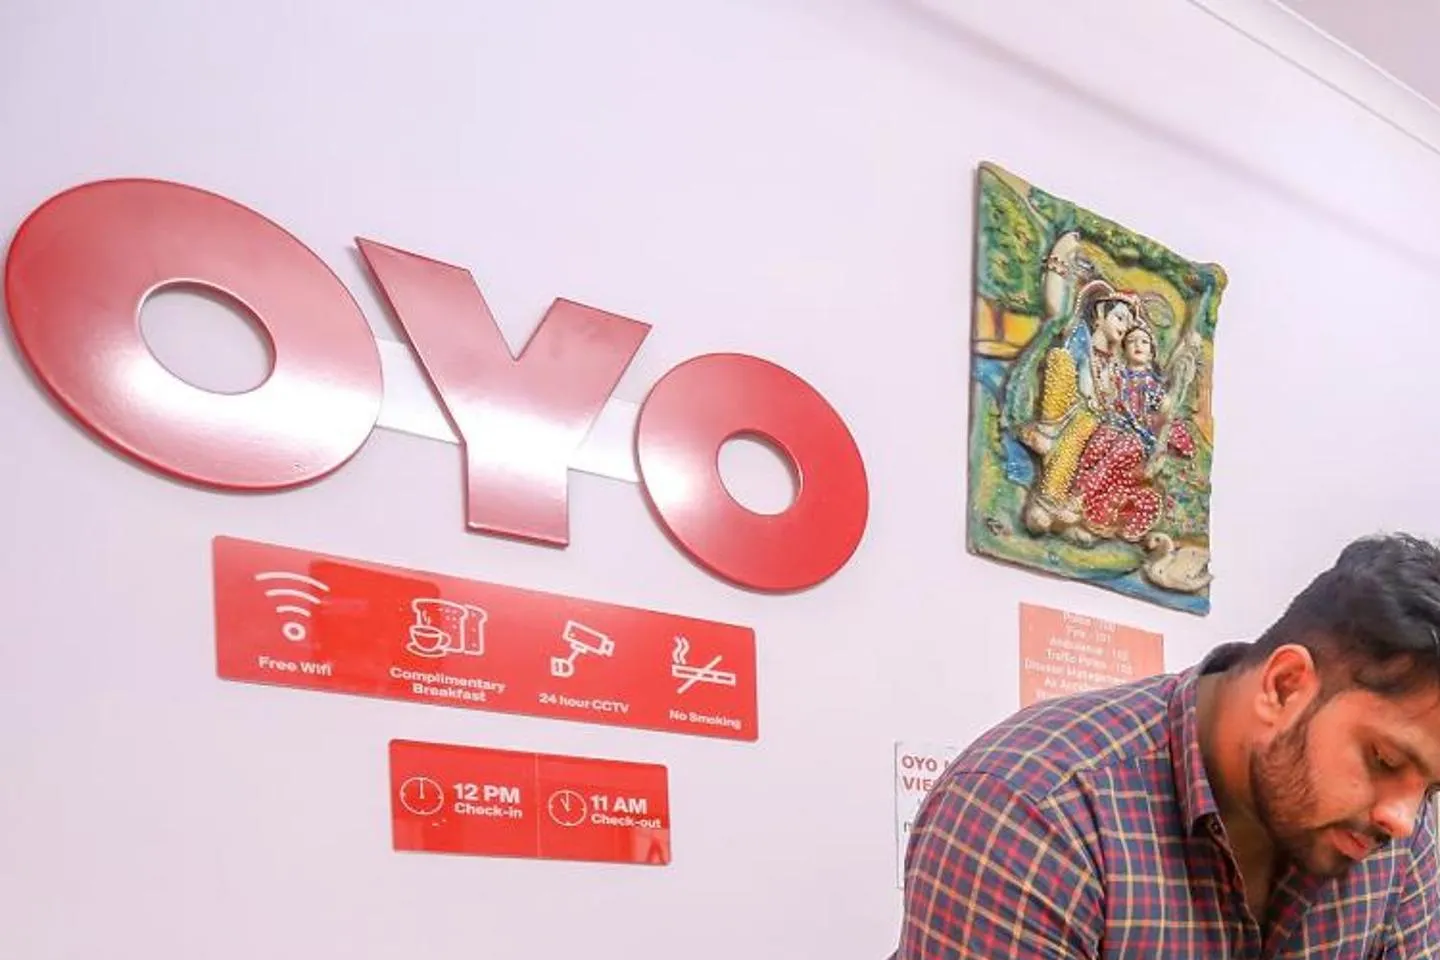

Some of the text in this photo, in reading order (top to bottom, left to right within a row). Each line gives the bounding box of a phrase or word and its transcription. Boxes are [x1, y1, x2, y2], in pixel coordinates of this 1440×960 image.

[5, 178, 868, 593] OYO
[258, 656, 332, 677] Free Wifi
[389, 667, 506, 693] Complimentary
[412, 684, 487, 702] Breakfast
[539, 692, 629, 714] 24 hour CCTV
[669, 709, 743, 731] No Smoking
[902, 755, 938, 772] OYO
[453, 783, 521, 804] 12 PM
[902, 776, 932, 792] VIE
[454, 801, 523, 819] Check-in
[590, 795, 648, 814] 11 AM
[591, 813, 662, 829] Check-out
